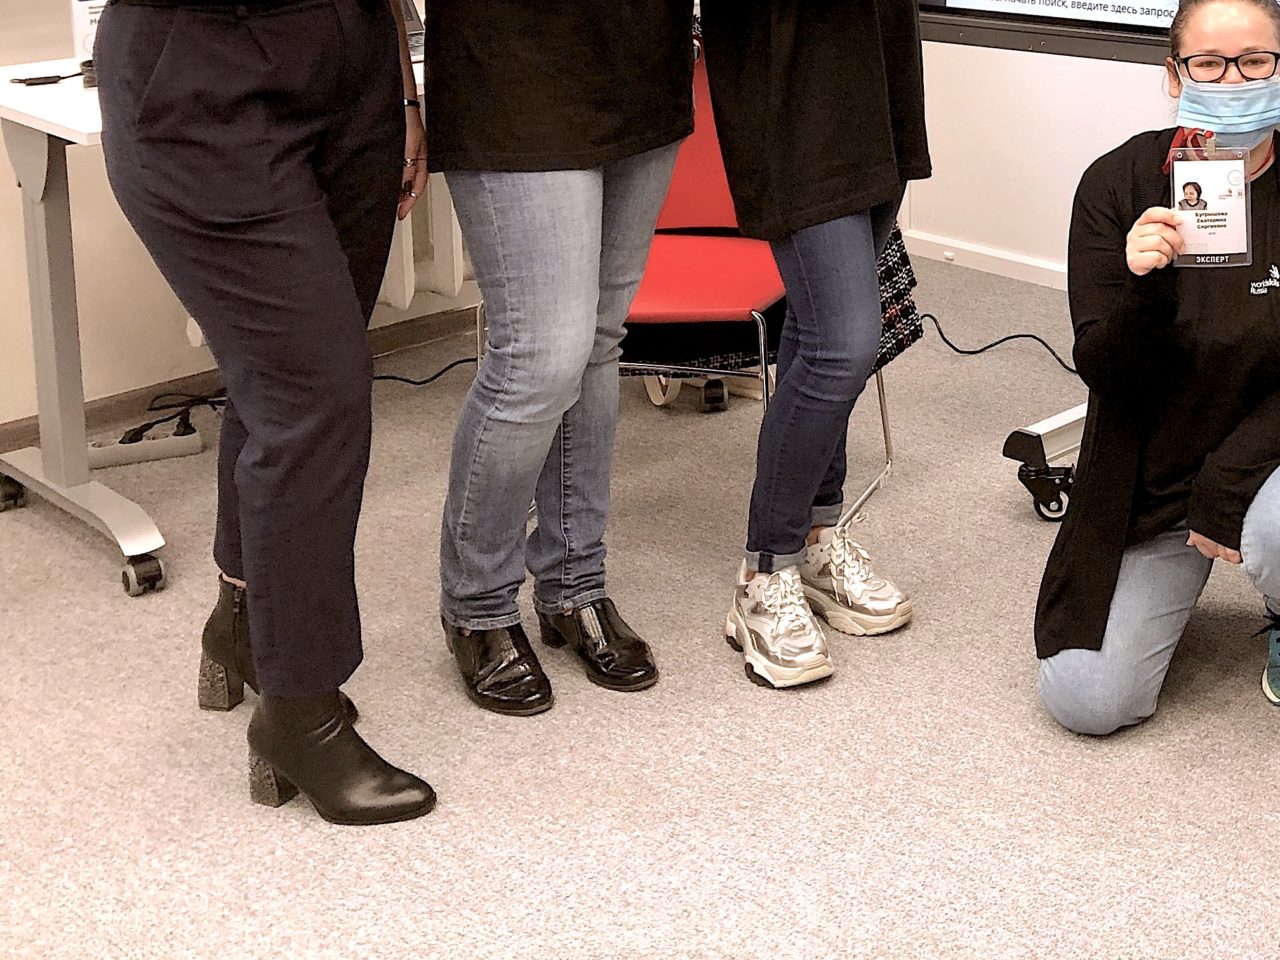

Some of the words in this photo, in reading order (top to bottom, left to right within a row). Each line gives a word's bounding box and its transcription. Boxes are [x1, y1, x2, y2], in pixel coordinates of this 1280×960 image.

[1071, 0, 1110, 14] введите
[1111, 3, 1138, 15] здесь
[1139, 5, 1175, 19] запрос
[1196, 255, 1230, 263] ЭКСПЕРТ
